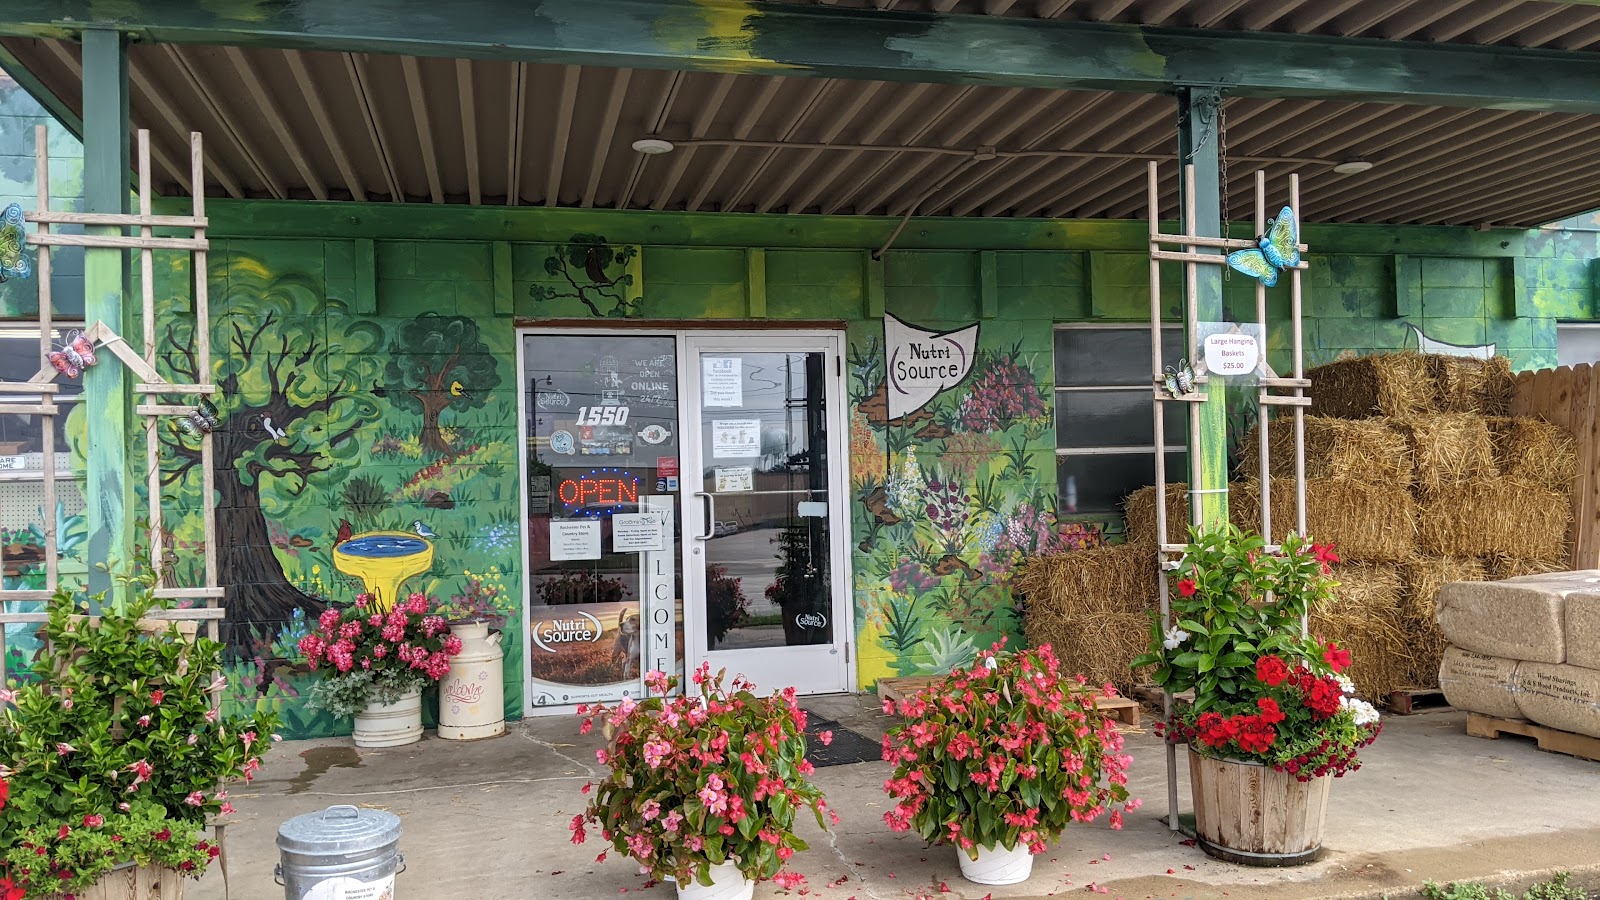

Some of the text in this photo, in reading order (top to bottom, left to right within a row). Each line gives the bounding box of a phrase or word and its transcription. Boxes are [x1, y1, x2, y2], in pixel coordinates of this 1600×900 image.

[909, 343, 950, 359] Nutri
[898, 361, 958, 380] Source
[631, 382, 669, 390] ONLINE
[576, 407, 630, 425] 1550
[559, 480, 636, 503] OPEN
[651, 510, 670, 673] WLCOME
[553, 619, 585, 632] Nutri
[800, 618, 822, 627] Source
[544, 628, 591, 642] Source
[444, 679, 484, 698] welcome
[537, 695, 546, 704] 4
